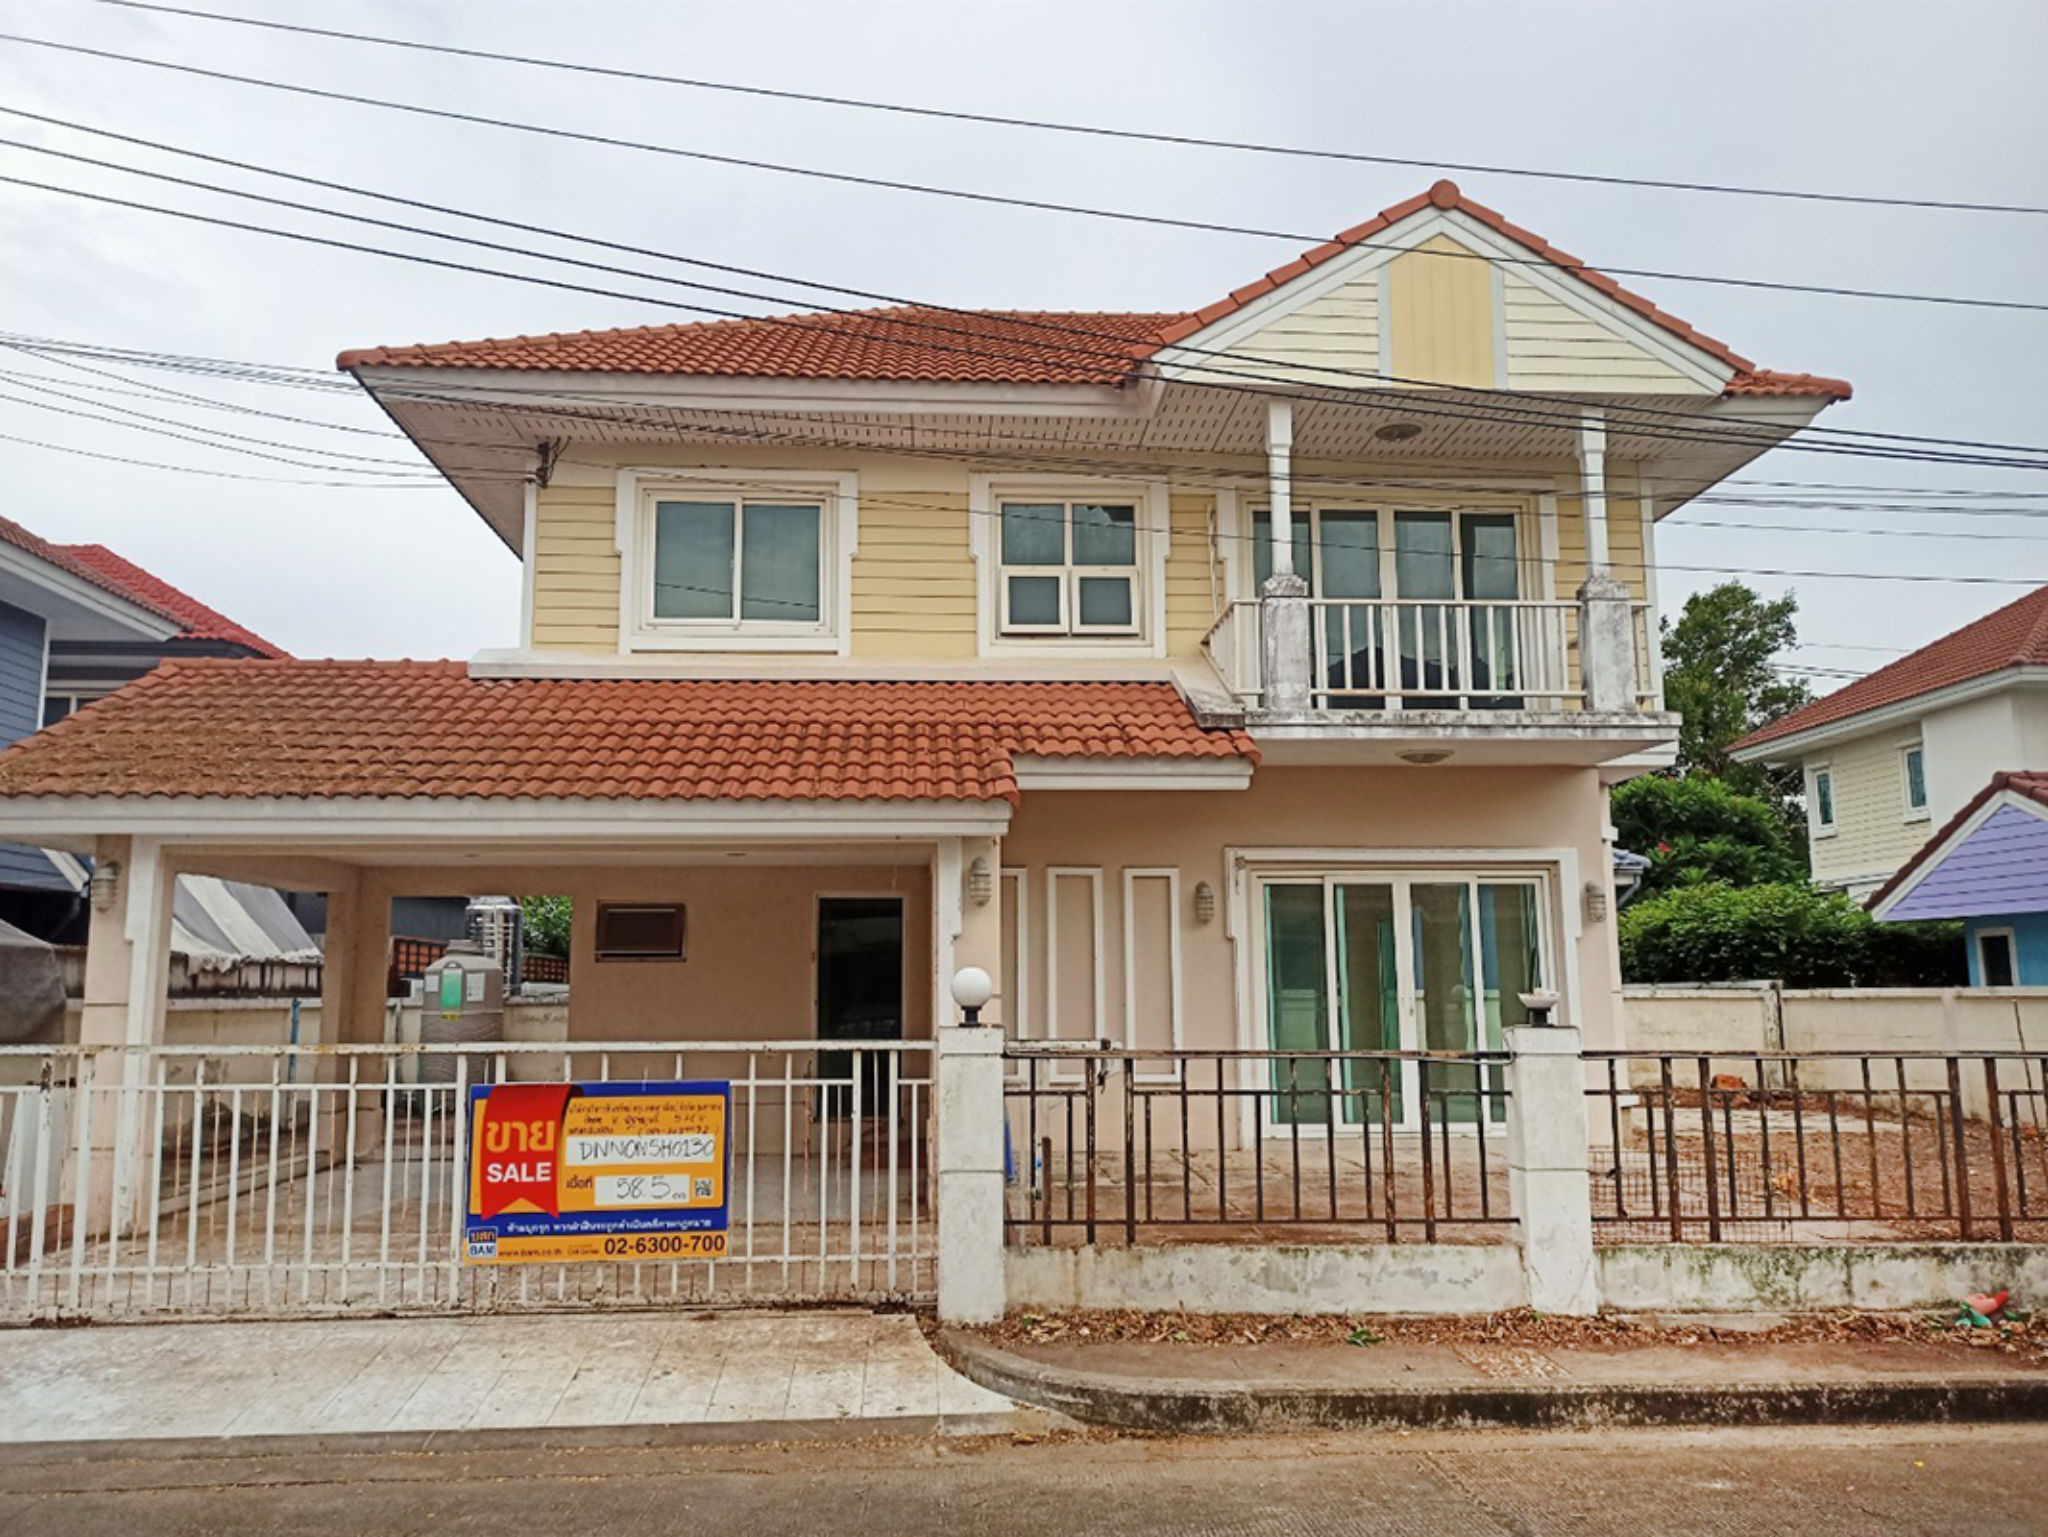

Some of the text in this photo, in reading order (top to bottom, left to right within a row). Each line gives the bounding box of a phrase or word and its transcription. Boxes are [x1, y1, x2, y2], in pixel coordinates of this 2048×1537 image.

[486, 1120, 555, 1153] ขาย
[486, 1162, 552, 1183] SALE
[604, 1235, 726, 1255] 02-6300-700
